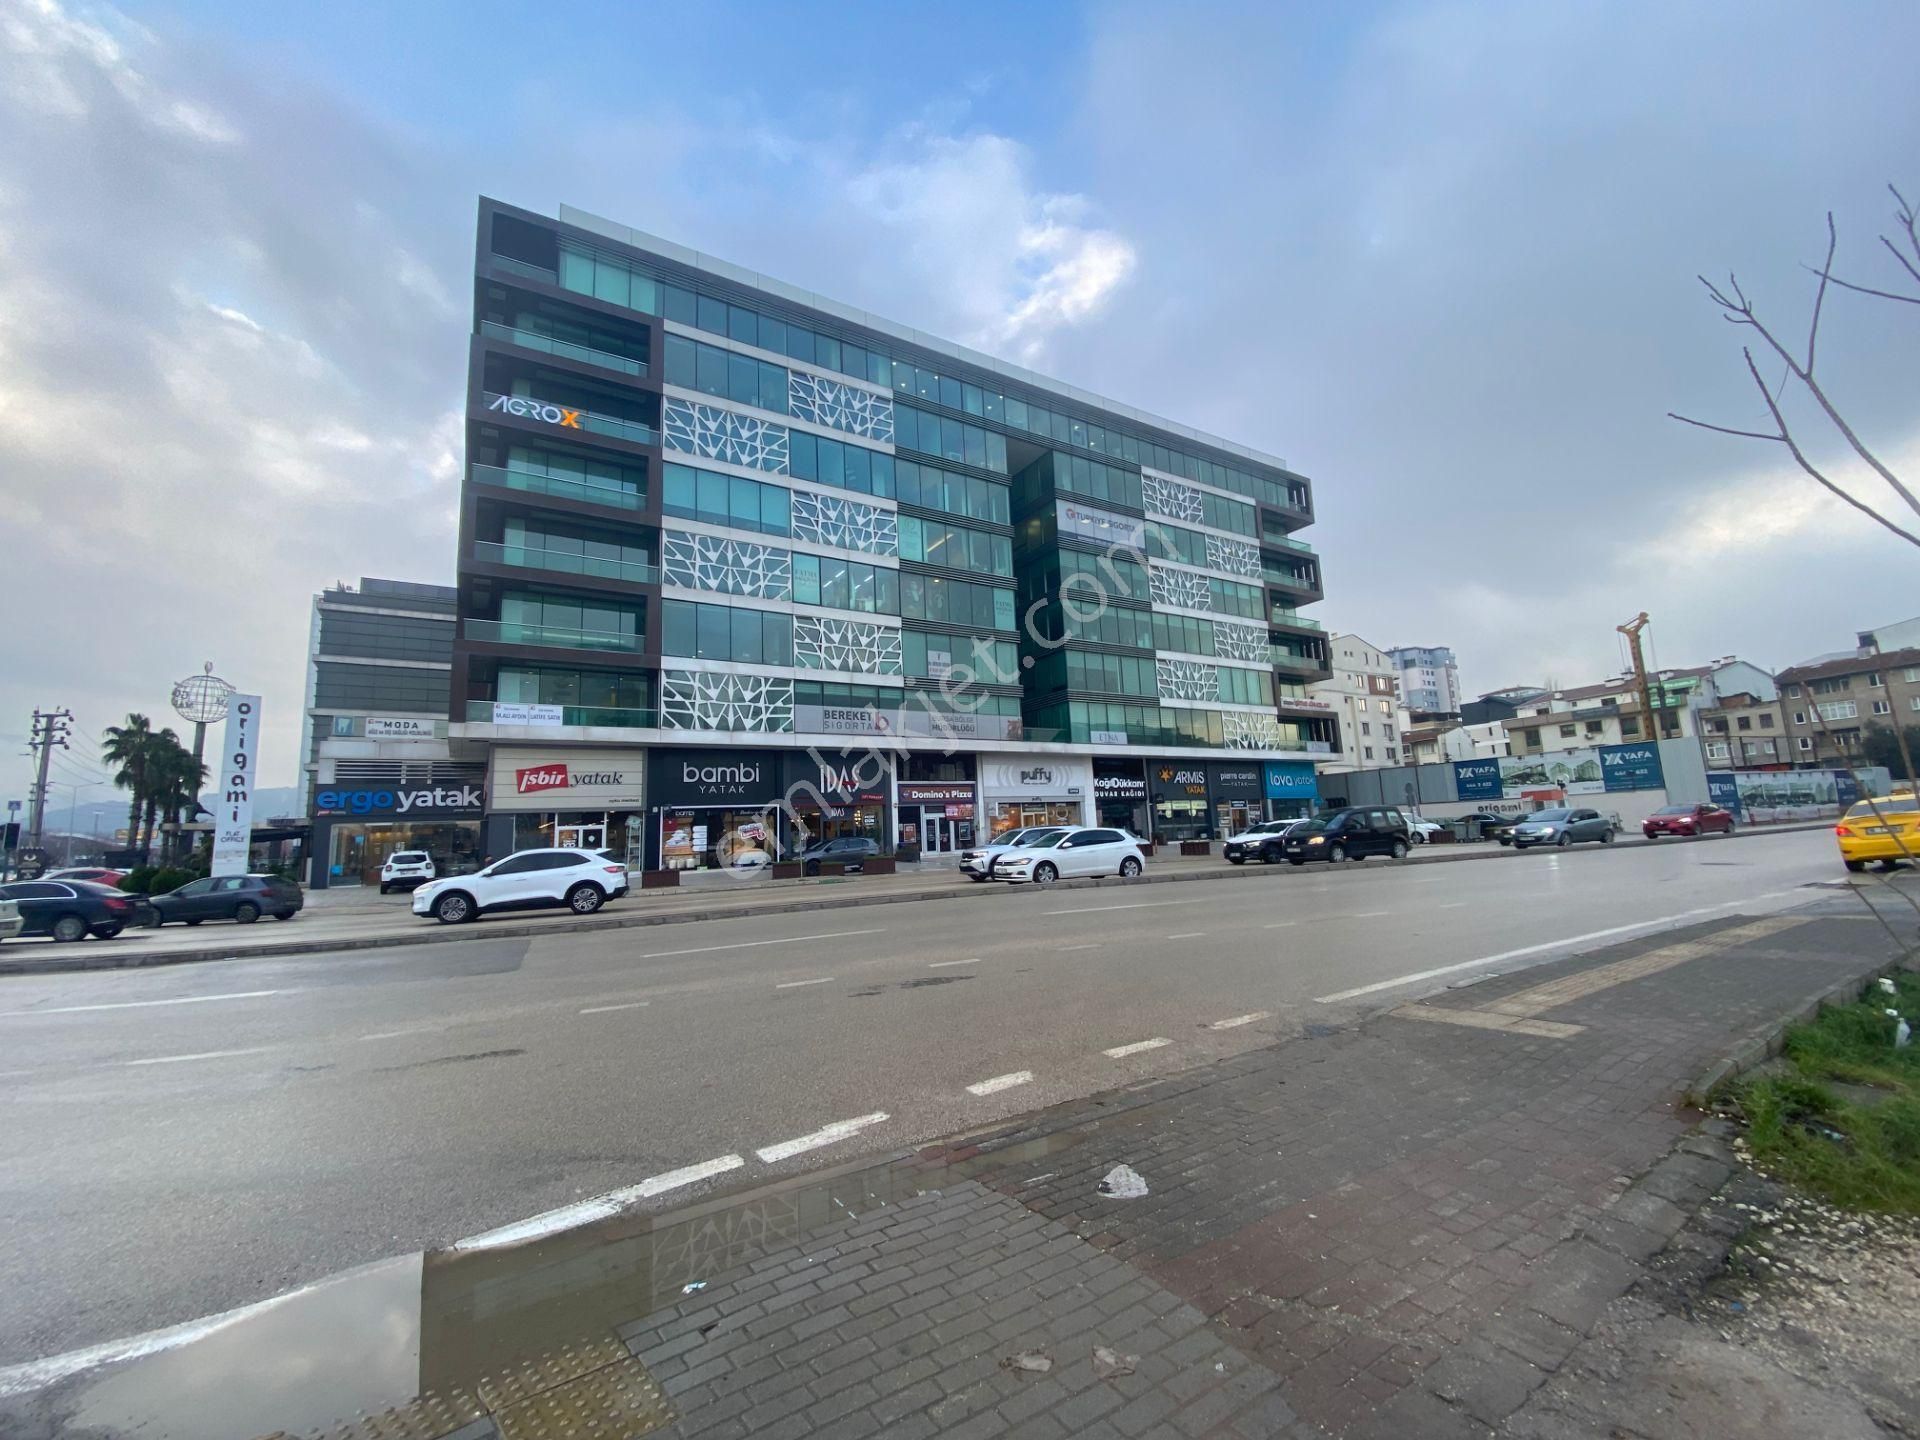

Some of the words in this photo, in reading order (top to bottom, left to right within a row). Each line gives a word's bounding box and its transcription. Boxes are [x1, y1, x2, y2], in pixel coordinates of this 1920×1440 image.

[489, 396, 579, 429] AGROX
[824, 710, 872, 721] BEREKET
[384, 721, 418, 729] MODA
[1623, 750, 1653, 760] YAFA
[226, 702, 251, 823] origami
[683, 762, 759, 782] bambi
[1020, 767, 1052, 784] puffy
[1474, 766, 1497, 774] YAFA
[570, 771, 623, 787] yatak
[1220, 772, 1238, 781] pierre
[1270, 770, 1293, 786] lova
[699, 785, 745, 794] YATAK
[912, 790, 950, 799] Domino's
[951, 790, 973, 798] Pizza
[1120, 789, 1145, 797] KAĞIDI
[1185, 786, 1206, 794] YATAK
[317, 789, 394, 814] ergo
[396, 785, 482, 813] yatak
[1478, 802, 1522, 814] origami
